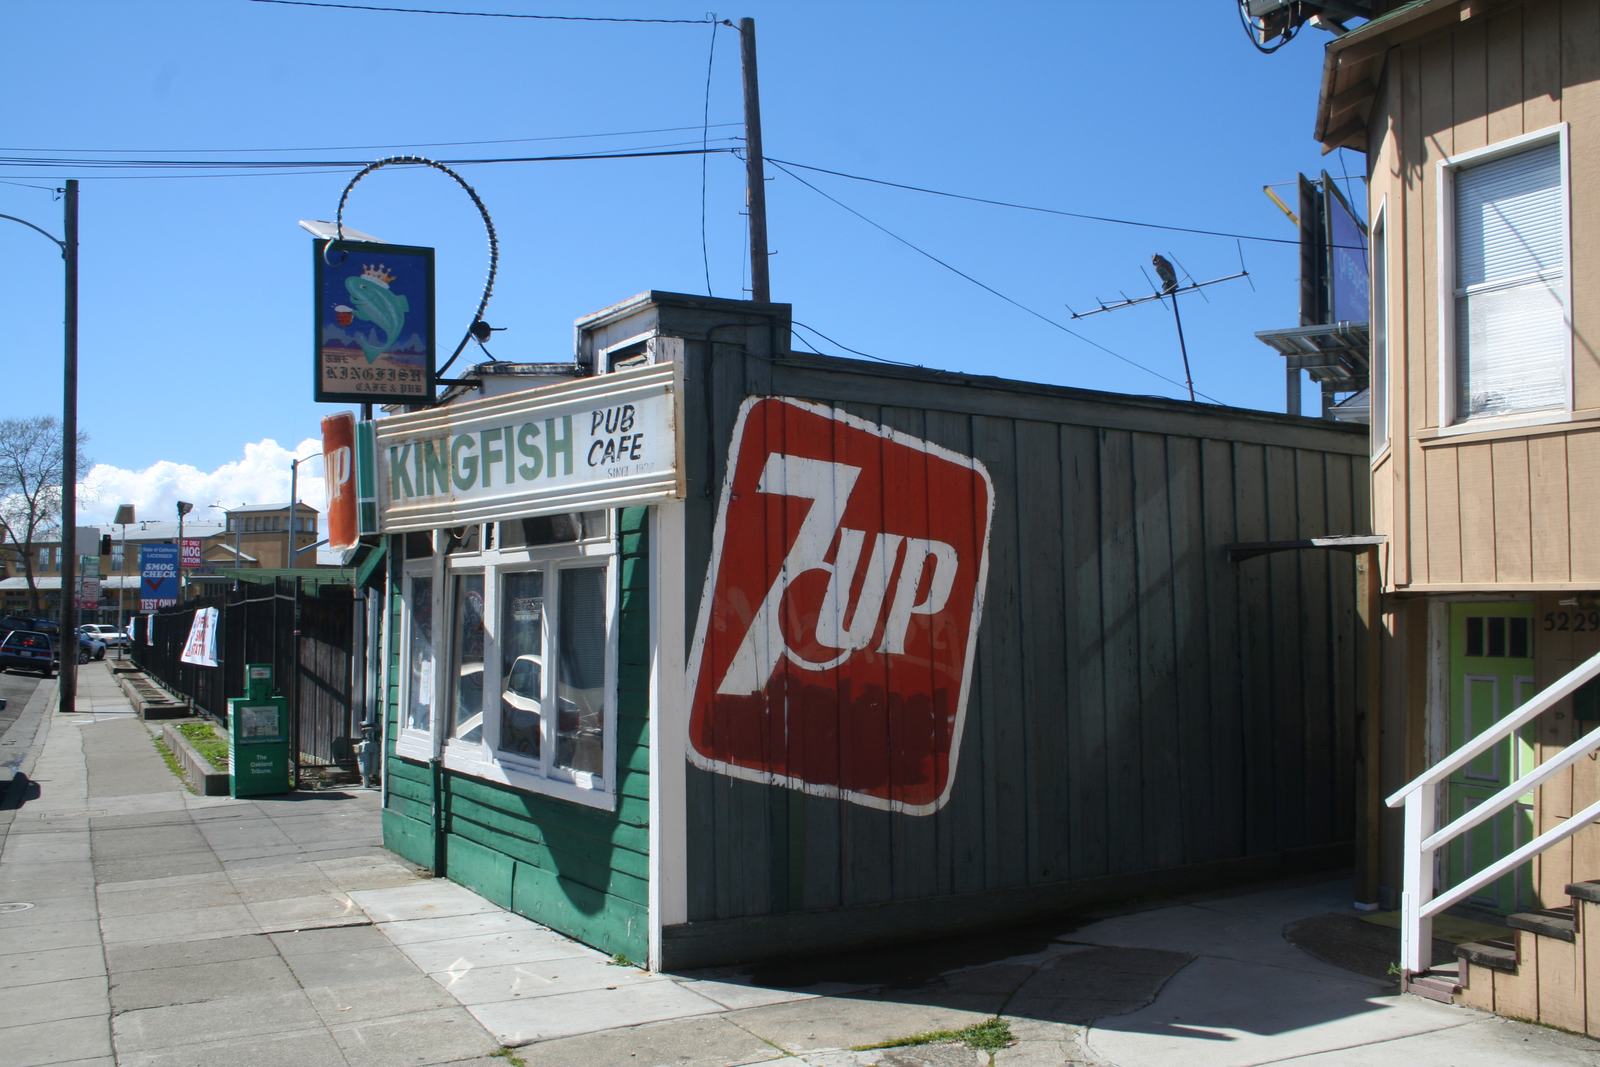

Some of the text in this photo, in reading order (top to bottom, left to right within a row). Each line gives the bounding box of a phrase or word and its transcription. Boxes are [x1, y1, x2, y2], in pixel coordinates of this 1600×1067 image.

[325, 366, 422, 381] KINGFISH
[591, 404, 635, 436] PUB
[390, 414, 574, 500] KINGFISH
[588, 433, 644, 467] CAFE
[182, 546, 200, 557] MOG
[142, 570, 176, 578] CHECK
[145, 563, 174, 571] SMOG
[140, 598, 158, 609] TEST
[1543, 611, 1599, 632] 5229
